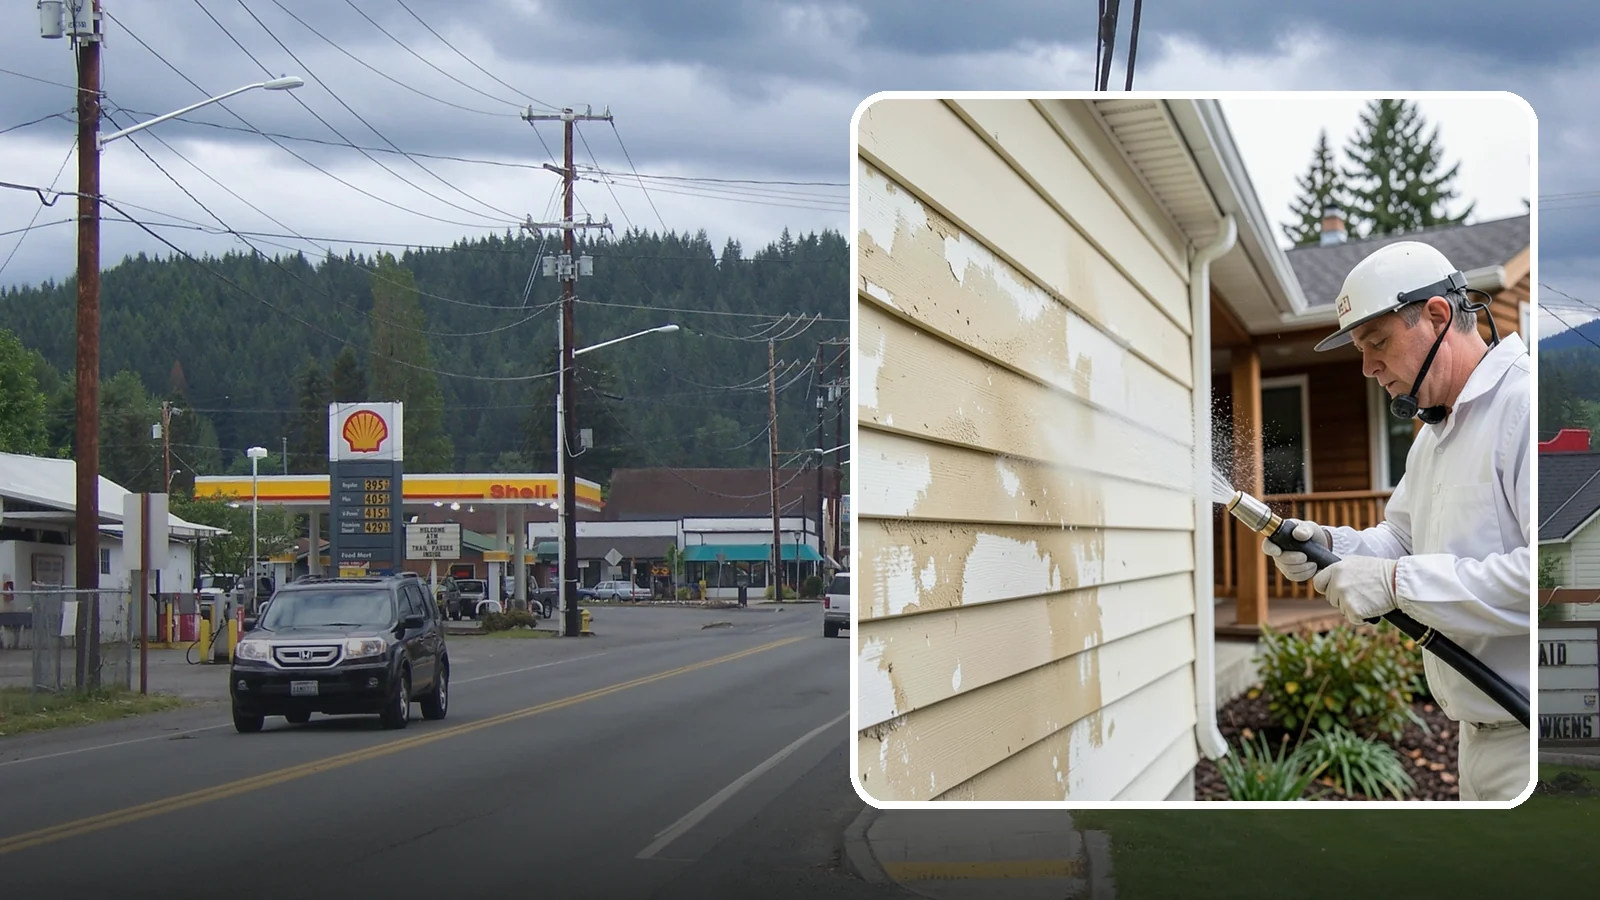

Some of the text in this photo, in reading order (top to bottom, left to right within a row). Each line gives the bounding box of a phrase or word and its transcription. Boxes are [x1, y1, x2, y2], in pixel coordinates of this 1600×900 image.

[366, 480, 384, 490] 395
[490, 484, 548, 499] Shell
[366, 494, 384, 504] 405
[366, 508, 384, 518] 415
[366, 522, 384, 533] 429
